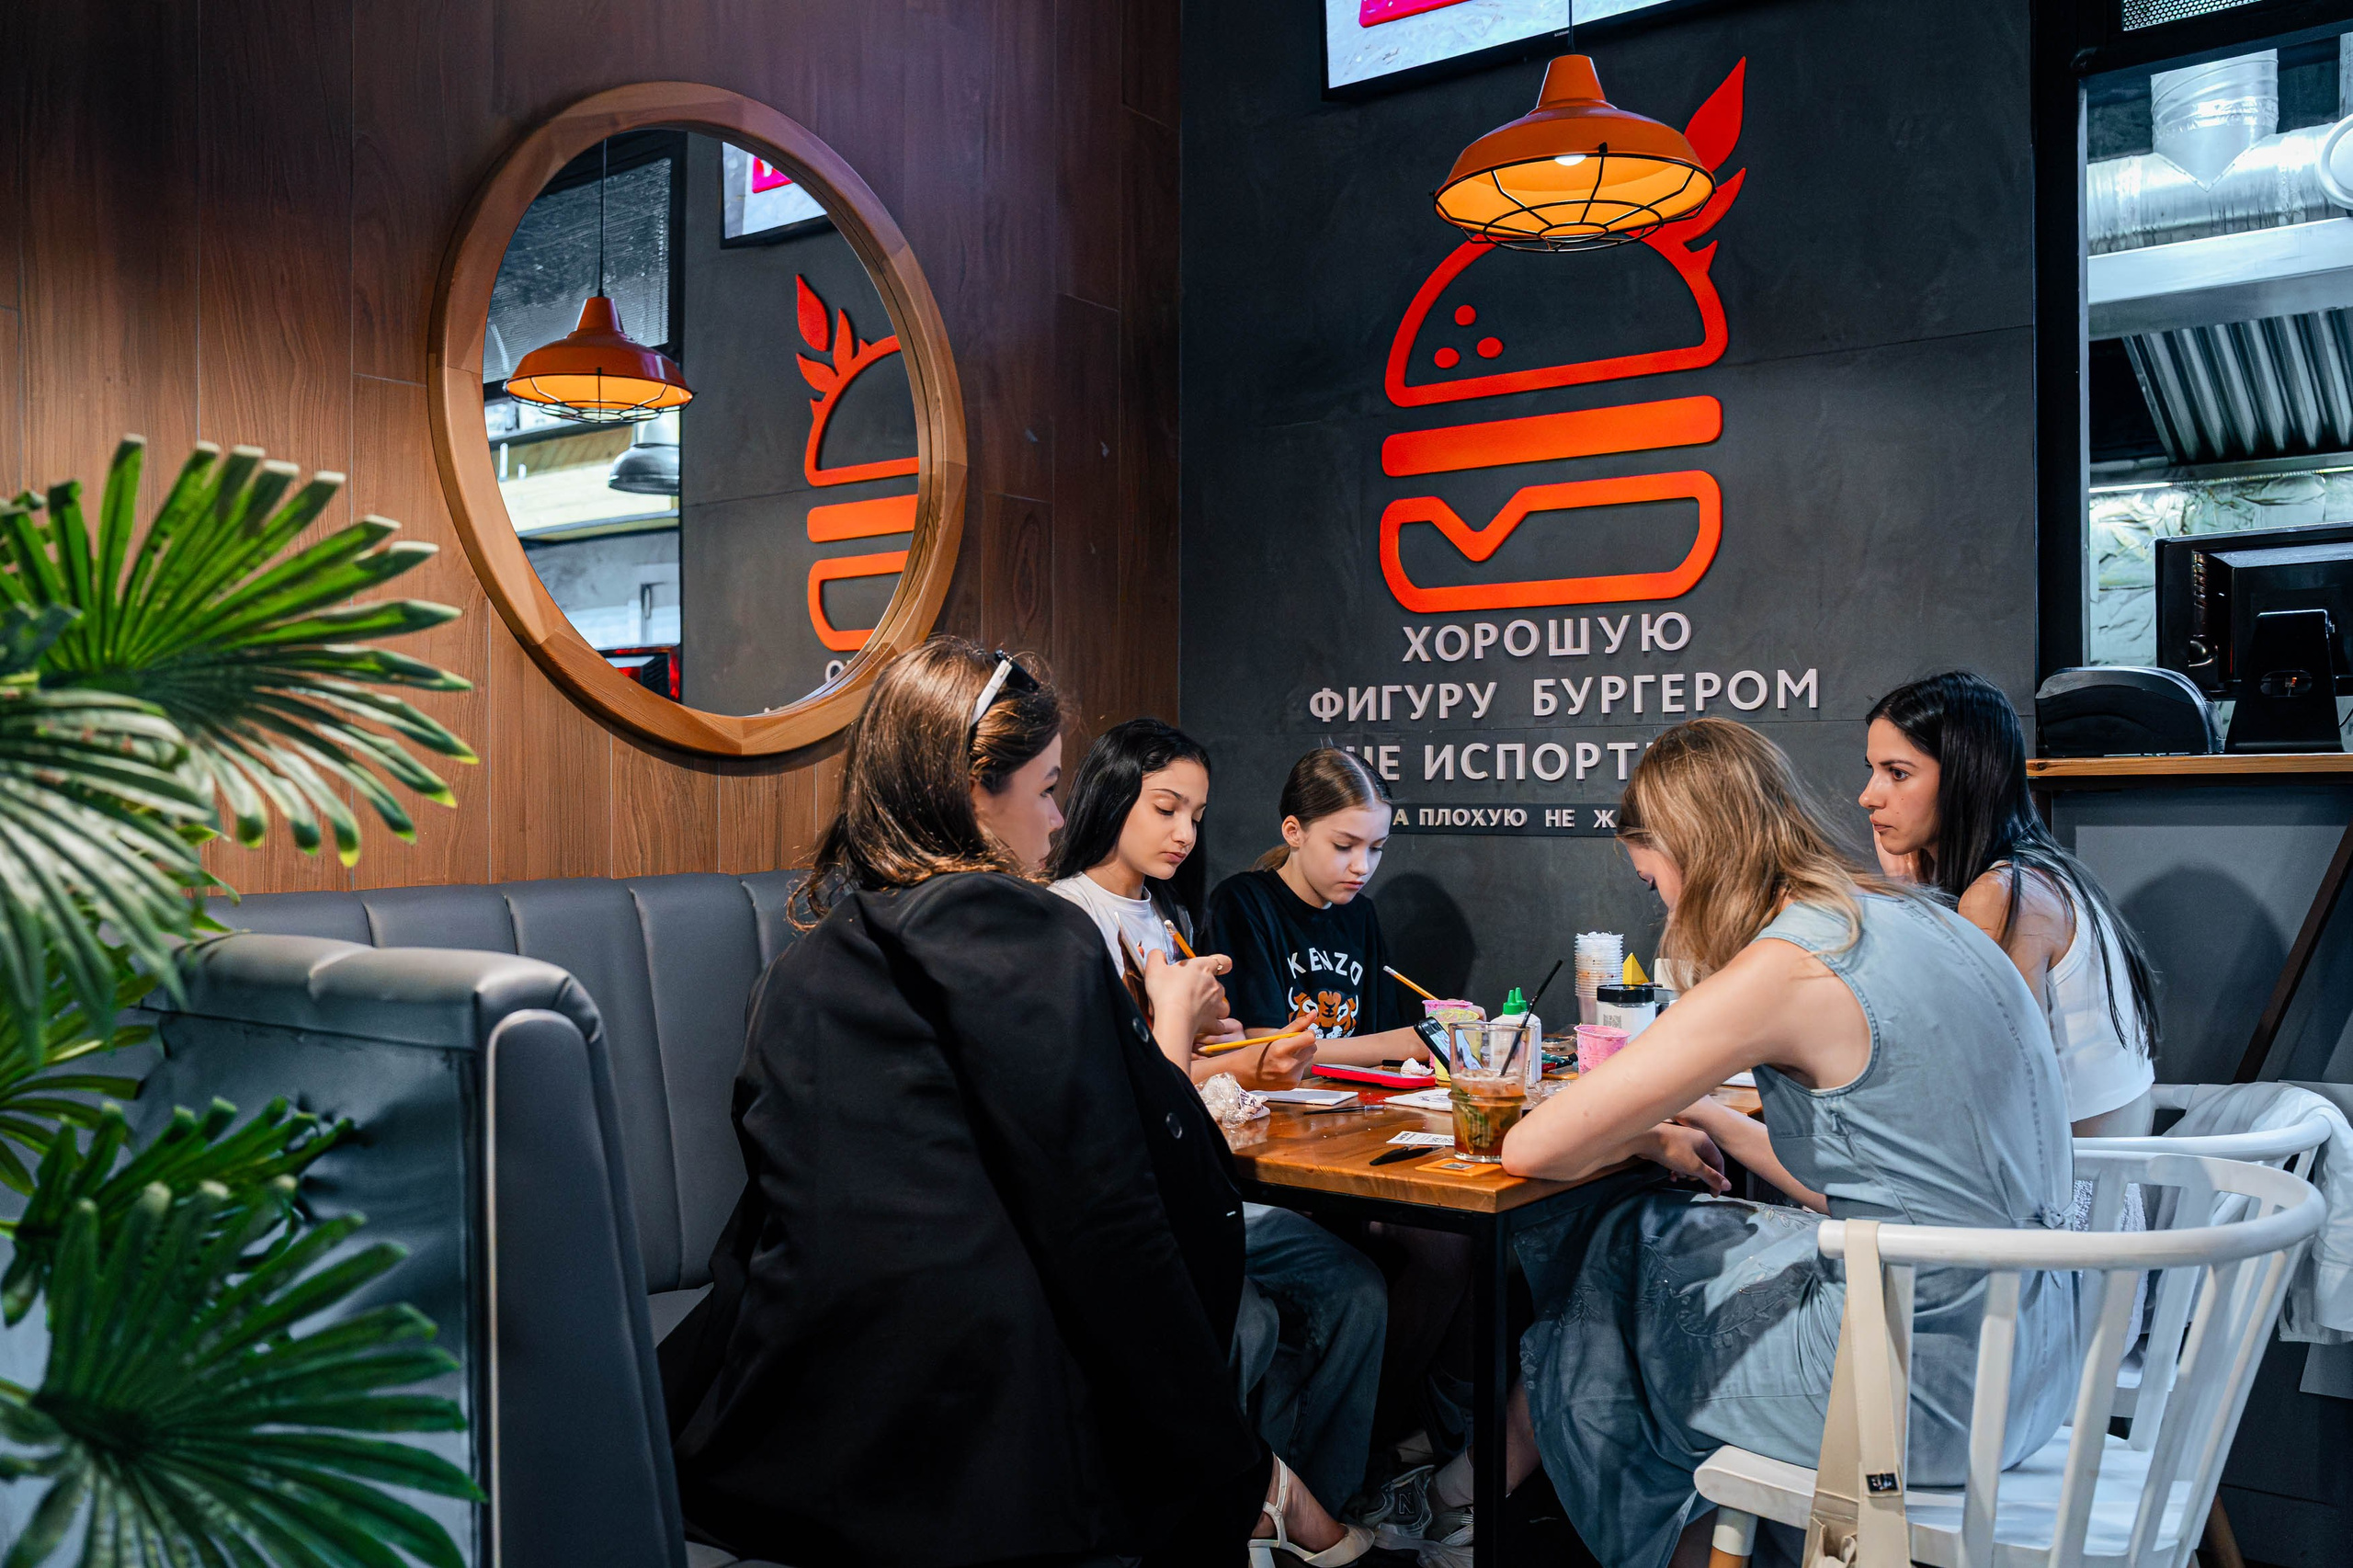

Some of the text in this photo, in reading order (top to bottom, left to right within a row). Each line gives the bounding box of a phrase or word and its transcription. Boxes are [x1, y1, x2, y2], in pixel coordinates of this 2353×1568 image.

[1402, 611, 1692, 663] ХОРОШУЮ
[1309, 668, 1819, 722] ФИГУРУ БУРГЕРОМ
[1424, 742, 1654, 781] ИСПОРТ
[1392, 808, 1410, 826] А
[1419, 808, 1529, 827] ПЛОХУЮ
[1545, 809, 1575, 827] НЕ
[1287, 947, 1363, 985] KENZO
